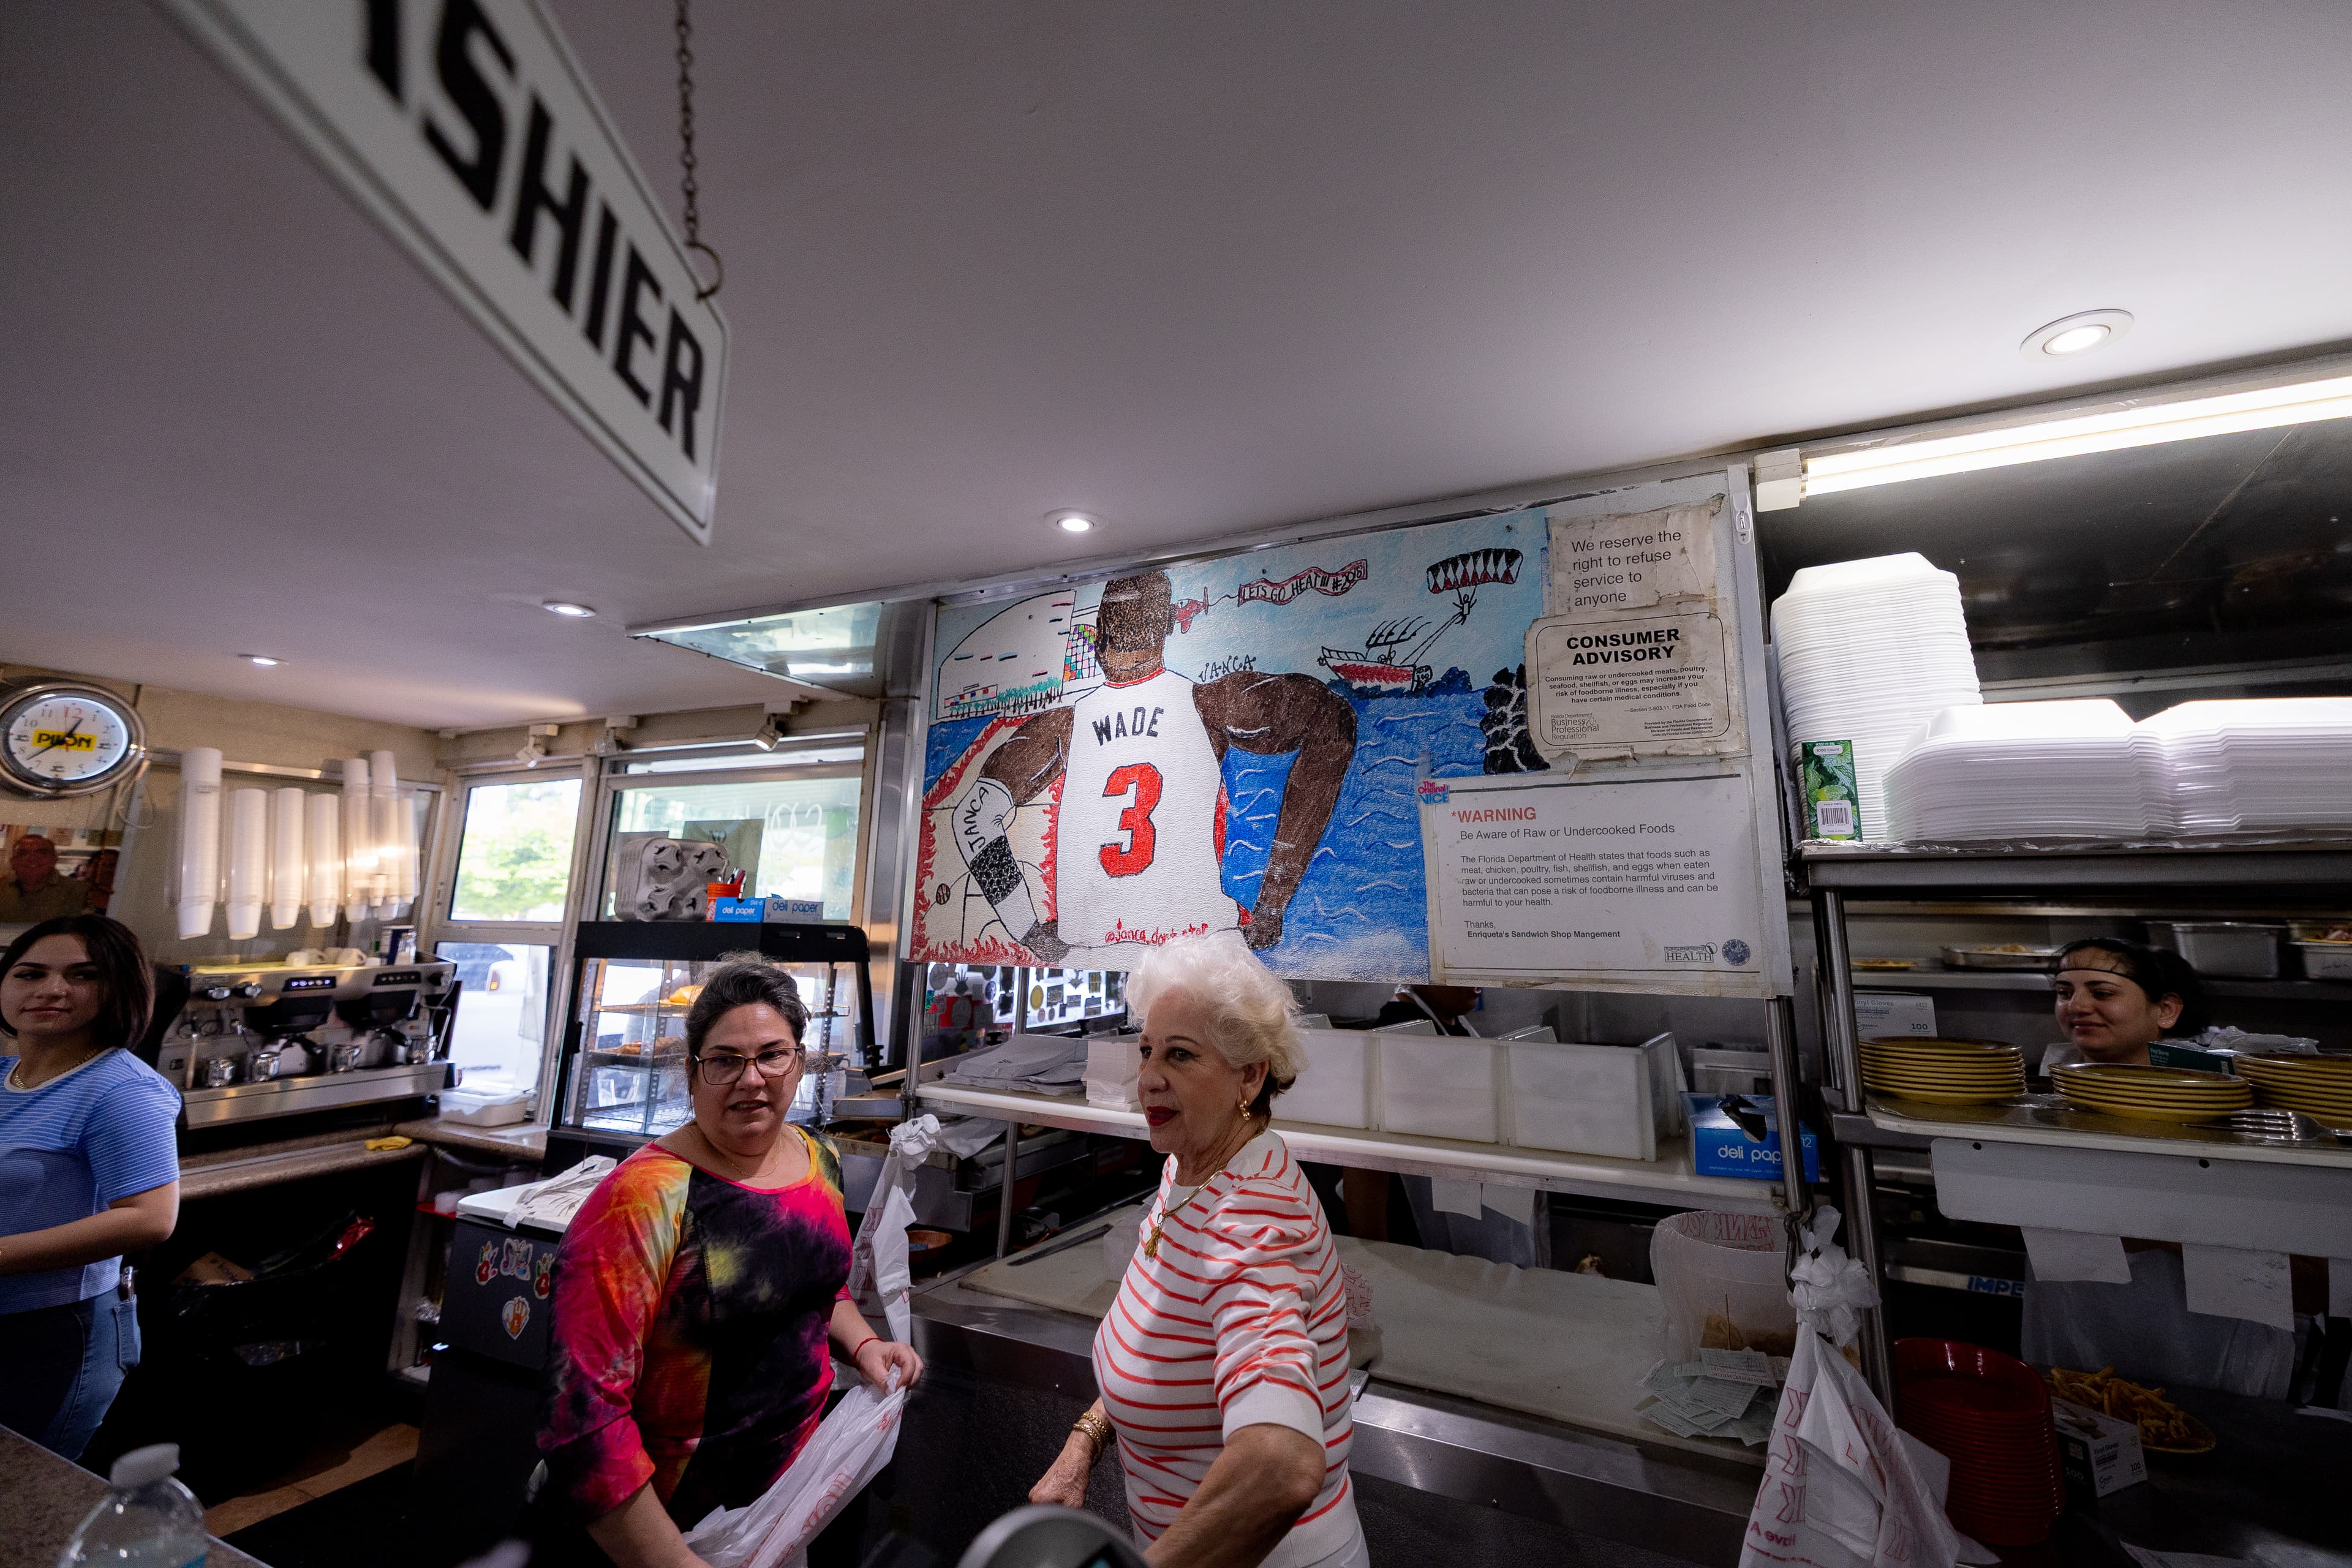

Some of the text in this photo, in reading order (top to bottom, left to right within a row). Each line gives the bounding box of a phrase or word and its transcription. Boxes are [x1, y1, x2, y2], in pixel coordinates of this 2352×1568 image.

[1571, 530, 1681, 552] We reserve the
[1573, 550, 1672, 573] right to refuse
[1574, 571, 1642, 589] service to
[1243, 585, 1267, 600] LETS
[1270, 587, 1286, 602] GO
[1575, 592, 1627, 608] anyone
[1566, 628, 1681, 650] CONSUMER
[1572, 645, 1675, 666] ADVISORY
[1608, 669, 1653, 679] undercooked
[1641, 683, 1676, 692] especially
[1643, 691, 1683, 699] conditions.
[41, 709, 54, 718] 11
[64, 706, 83, 719] 12
[24, 719, 38, 728] 10
[1092, 706, 1164, 746] WADE
[1551, 724, 1599, 733] Professional
[1417, 784, 1446, 794] Original
[1418, 790, 1449, 804] VICE
[967, 787, 990, 852] JANCA
[1099, 762, 1163, 878] 3
[1460, 823, 1675, 840] Be Aware of Raw or Undercooked Foods
[1478, 854, 1506, 863] Florida
[1507, 853, 1556, 864] Department
[1558, 853, 1567, 862] of
[1569, 852, 1596, 861] Health
[1598, 852, 1625, 861] states
[1626, 850, 1645, 859] that
[1646, 850, 1672, 859] foods
[1674, 848, 1696, 858] such
[1461, 861, 1710, 875] meat, chicken, poultry, fish, shellfish, and eggs when eaten
[1488, 876, 1542, 885] undercooked
[1544, 875, 1590, 884] sometimes
[1591, 874, 1624, 883] contain
[1625, 873, 1659, 883] harmful
[1661, 873, 1695, 881] viruses
[1697, 872, 1715, 880] and
[1462, 888, 1494, 896] bacteria
[1496, 888, 1512, 896] that
[1531, 888, 1552, 897] pose
[1561, 886, 1577, 895] risk
[1578, 886, 1588, 895] of
[1589, 885, 1634, 894] foodborne
[1636, 884, 1665, 894] illness
[1667, 884, 1684, 893] and
[1706, 883, 1719, 892] be
[772, 900, 819, 914] deli paper
[1462, 898, 1493, 907] harmful
[1504, 899, 1523, 908] your
[1525, 897, 1554, 906] health.
[735, 907, 755, 916] paper
[1463, 920, 1496, 930] Thanks,
[1467, 930, 1510, 940] Enriqueta's
[1550, 930, 1572, 940] Shop
[1574, 930, 1621, 940] Mangement
[1666, 951, 1712, 962] HEALTH
[1717, 1144, 1782, 1164] deli pap
[2130, 1461, 2141, 1472] 100
